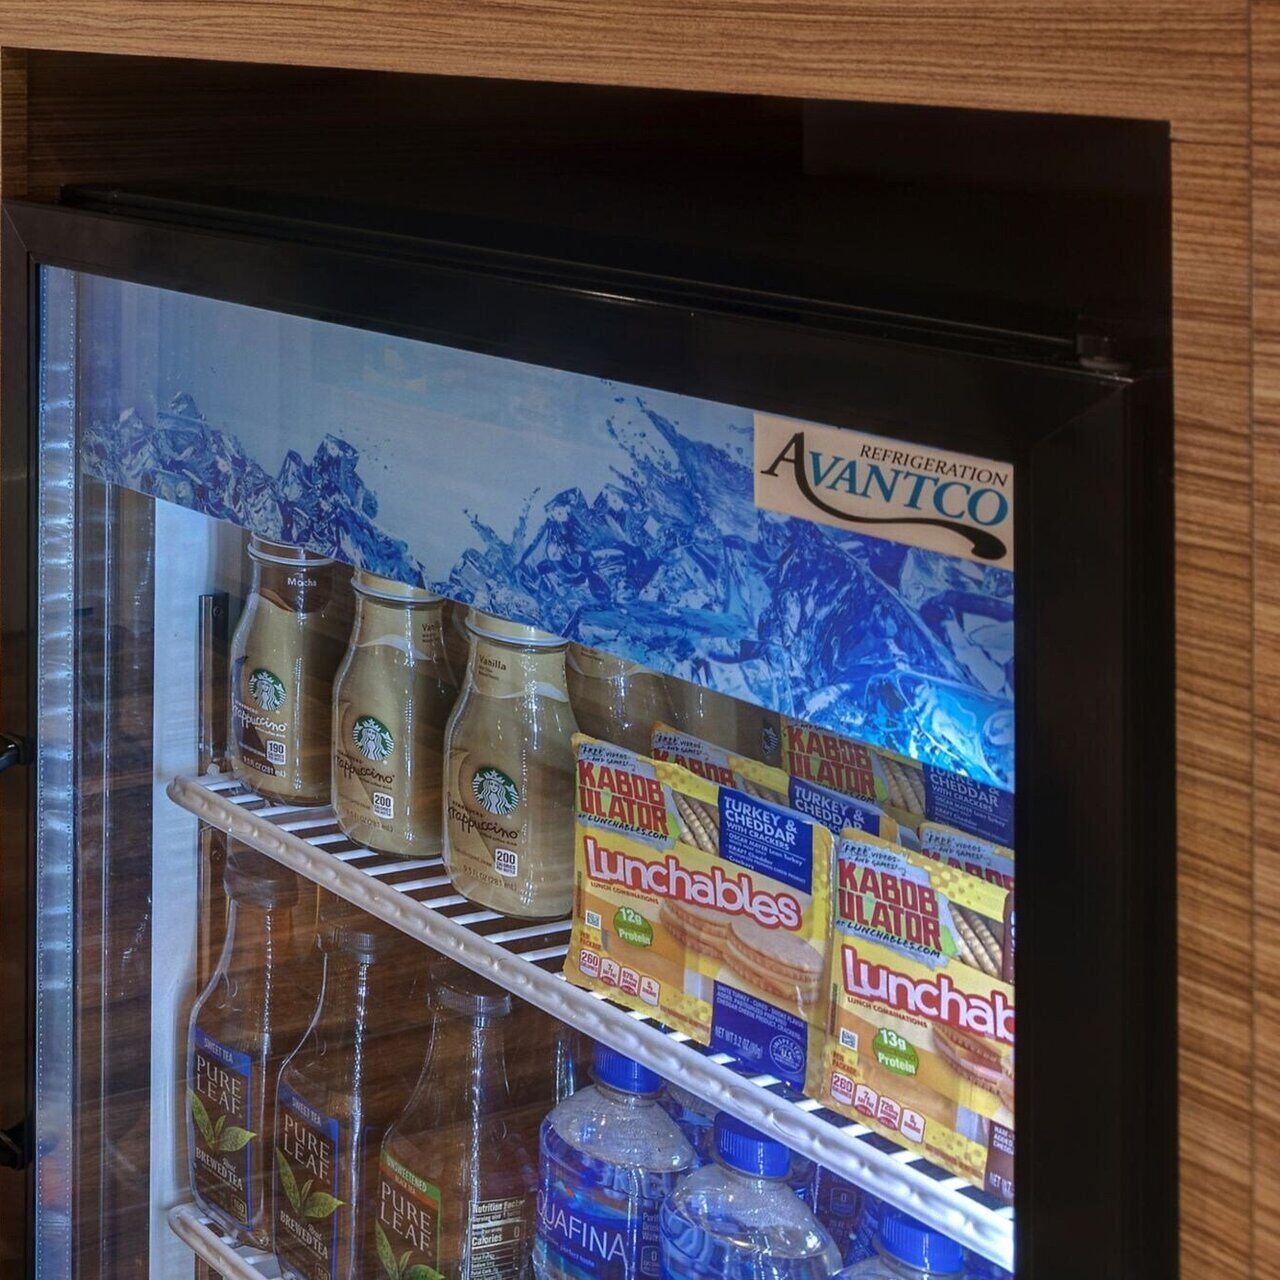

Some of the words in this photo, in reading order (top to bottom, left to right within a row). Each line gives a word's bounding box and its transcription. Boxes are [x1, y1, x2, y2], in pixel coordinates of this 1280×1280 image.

[760, 431, 1009, 535] AVANTCO
[860, 444, 1008, 487] REFRIGERATION
[287, 577, 317, 587] Mocha
[479, 654, 507, 671] Vanilla
[268, 742, 285, 755] 190
[787, 726, 869, 767] KABOB
[577, 759, 664, 806] KABOB
[930, 774, 998, 807] CHEDDAR
[374, 795, 391, 808] 200
[579, 785, 670, 835] ULATOR
[724, 795, 780, 824] TURKEY
[786, 819, 798, 833] &
[795, 786, 847, 815] TURKEY
[853, 809, 865, 824] &
[795, 799, 862, 829] CHEDDAR
[586, 812, 668, 841] LUNCHABLES.COM
[725, 810, 796, 844] CHEDDAR
[726, 822, 746, 835] WITH
[748, 828, 790, 851] CRACKERS
[496, 851, 515, 865] 200
[586, 837, 801, 928] Lunchables
[590, 881, 612, 892] LUNCH
[613, 887, 660, 905] COMBINATIONS
[838, 858, 939, 919] KABOB
[620, 909, 642, 925] 12g
[839, 888, 943, 952] ULATOR
[618, 928, 650, 945] Protein
[847, 921, 940, 959] LUNCHABLES.COM
[580, 951, 599, 966] 260
[843, 948, 1015, 1039] Lunchab
[847, 996, 872, 1009] LUNCH
[873, 1004, 928, 1028] COMBINATIONS
[204, 1037, 222, 1059] SWEET
[222, 1048, 234, 1064] TEA
[880, 1028, 907, 1051] 13g
[197, 1054, 242, 1099] PURE
[877, 1052, 916, 1075] Protein
[197, 1073, 242, 1117] LEAF
[292, 1097, 311, 1118] SWEET
[310, 1110, 322, 1127] TEA
[284, 1113, 330, 1161] PURE
[195, 1147, 228, 1180] BREWED
[227, 1171, 243, 1192] TEA
[284, 1133, 330, 1181] LEAF
[381, 1181, 432, 1235] PURE
[280, 1210, 312, 1247] BREWED
[312, 1238, 329, 1260] TEA
[379, 1201, 432, 1253] LEAF
[471, 1232, 503, 1247] Calories
